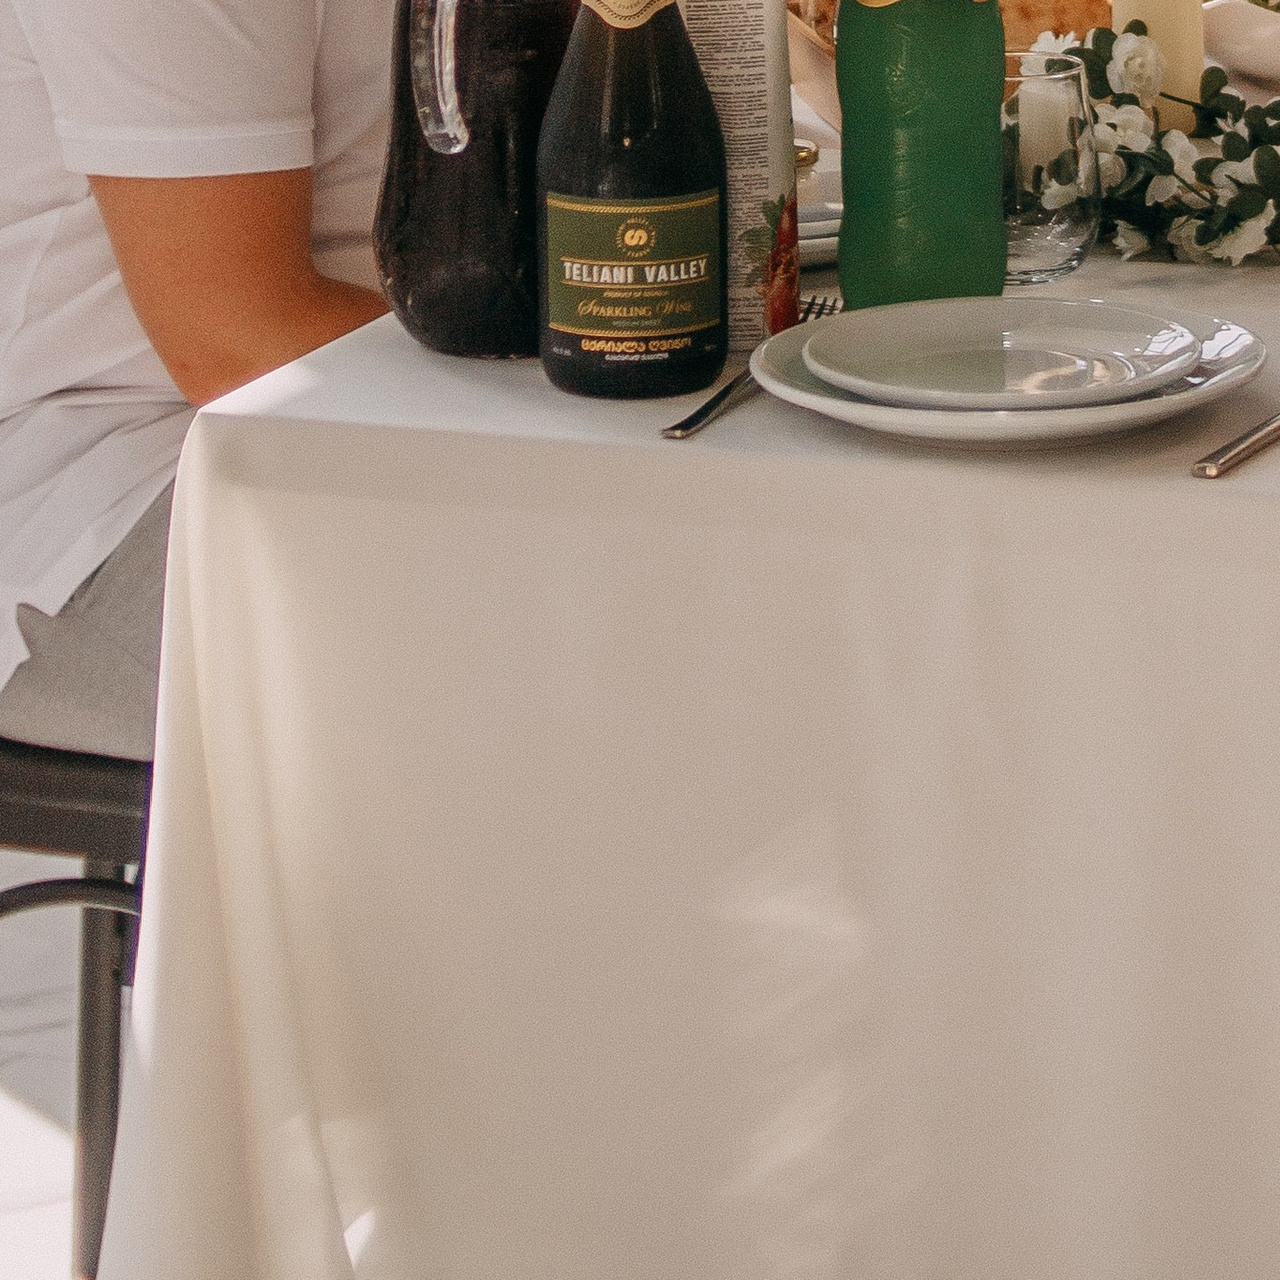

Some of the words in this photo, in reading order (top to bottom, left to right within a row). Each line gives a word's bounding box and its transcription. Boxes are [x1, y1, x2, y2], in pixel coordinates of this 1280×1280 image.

[563, 261, 633, 284] TELIANI
[645, 259, 708, 282] VALLEY
[577, 299, 652, 317] SPARKLING
